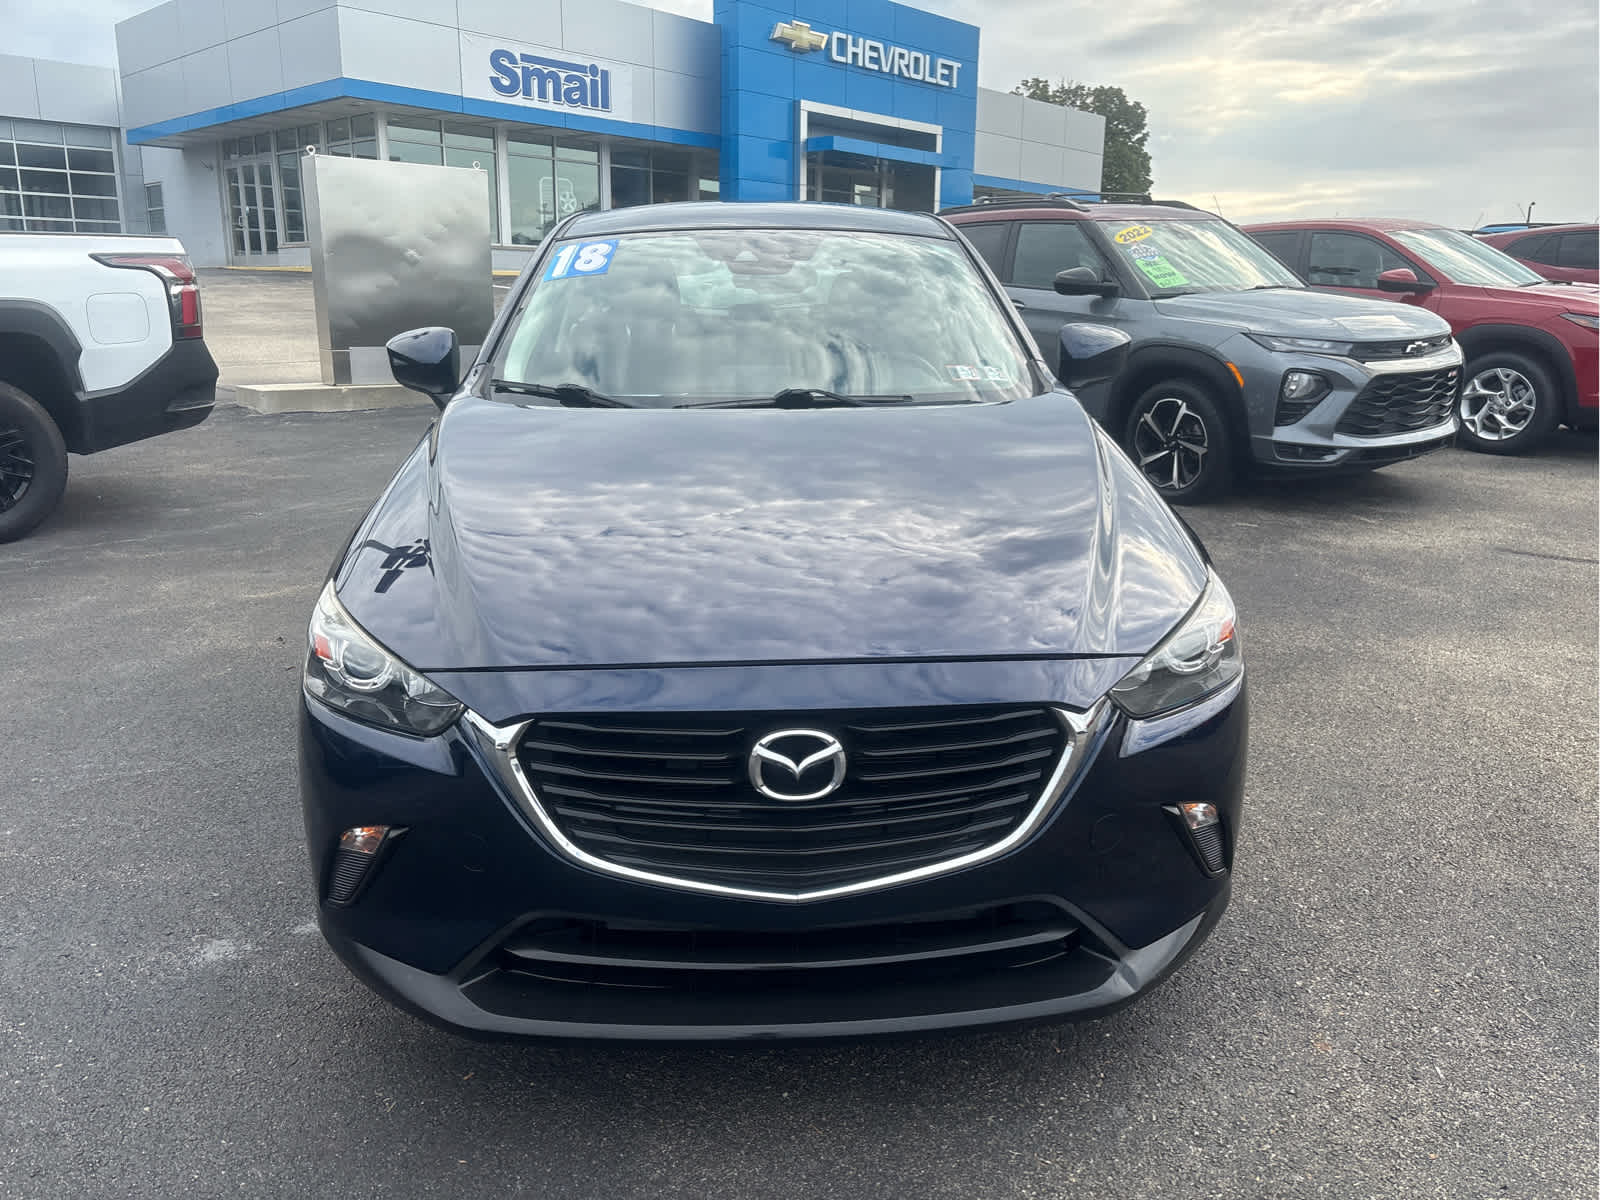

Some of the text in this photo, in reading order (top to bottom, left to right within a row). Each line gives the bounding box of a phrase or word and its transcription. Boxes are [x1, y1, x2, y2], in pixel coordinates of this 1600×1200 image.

[489, 49, 611, 111] Smail
[830, 31, 962, 88] CHEVROLET
[551, 243, 613, 278] 18
